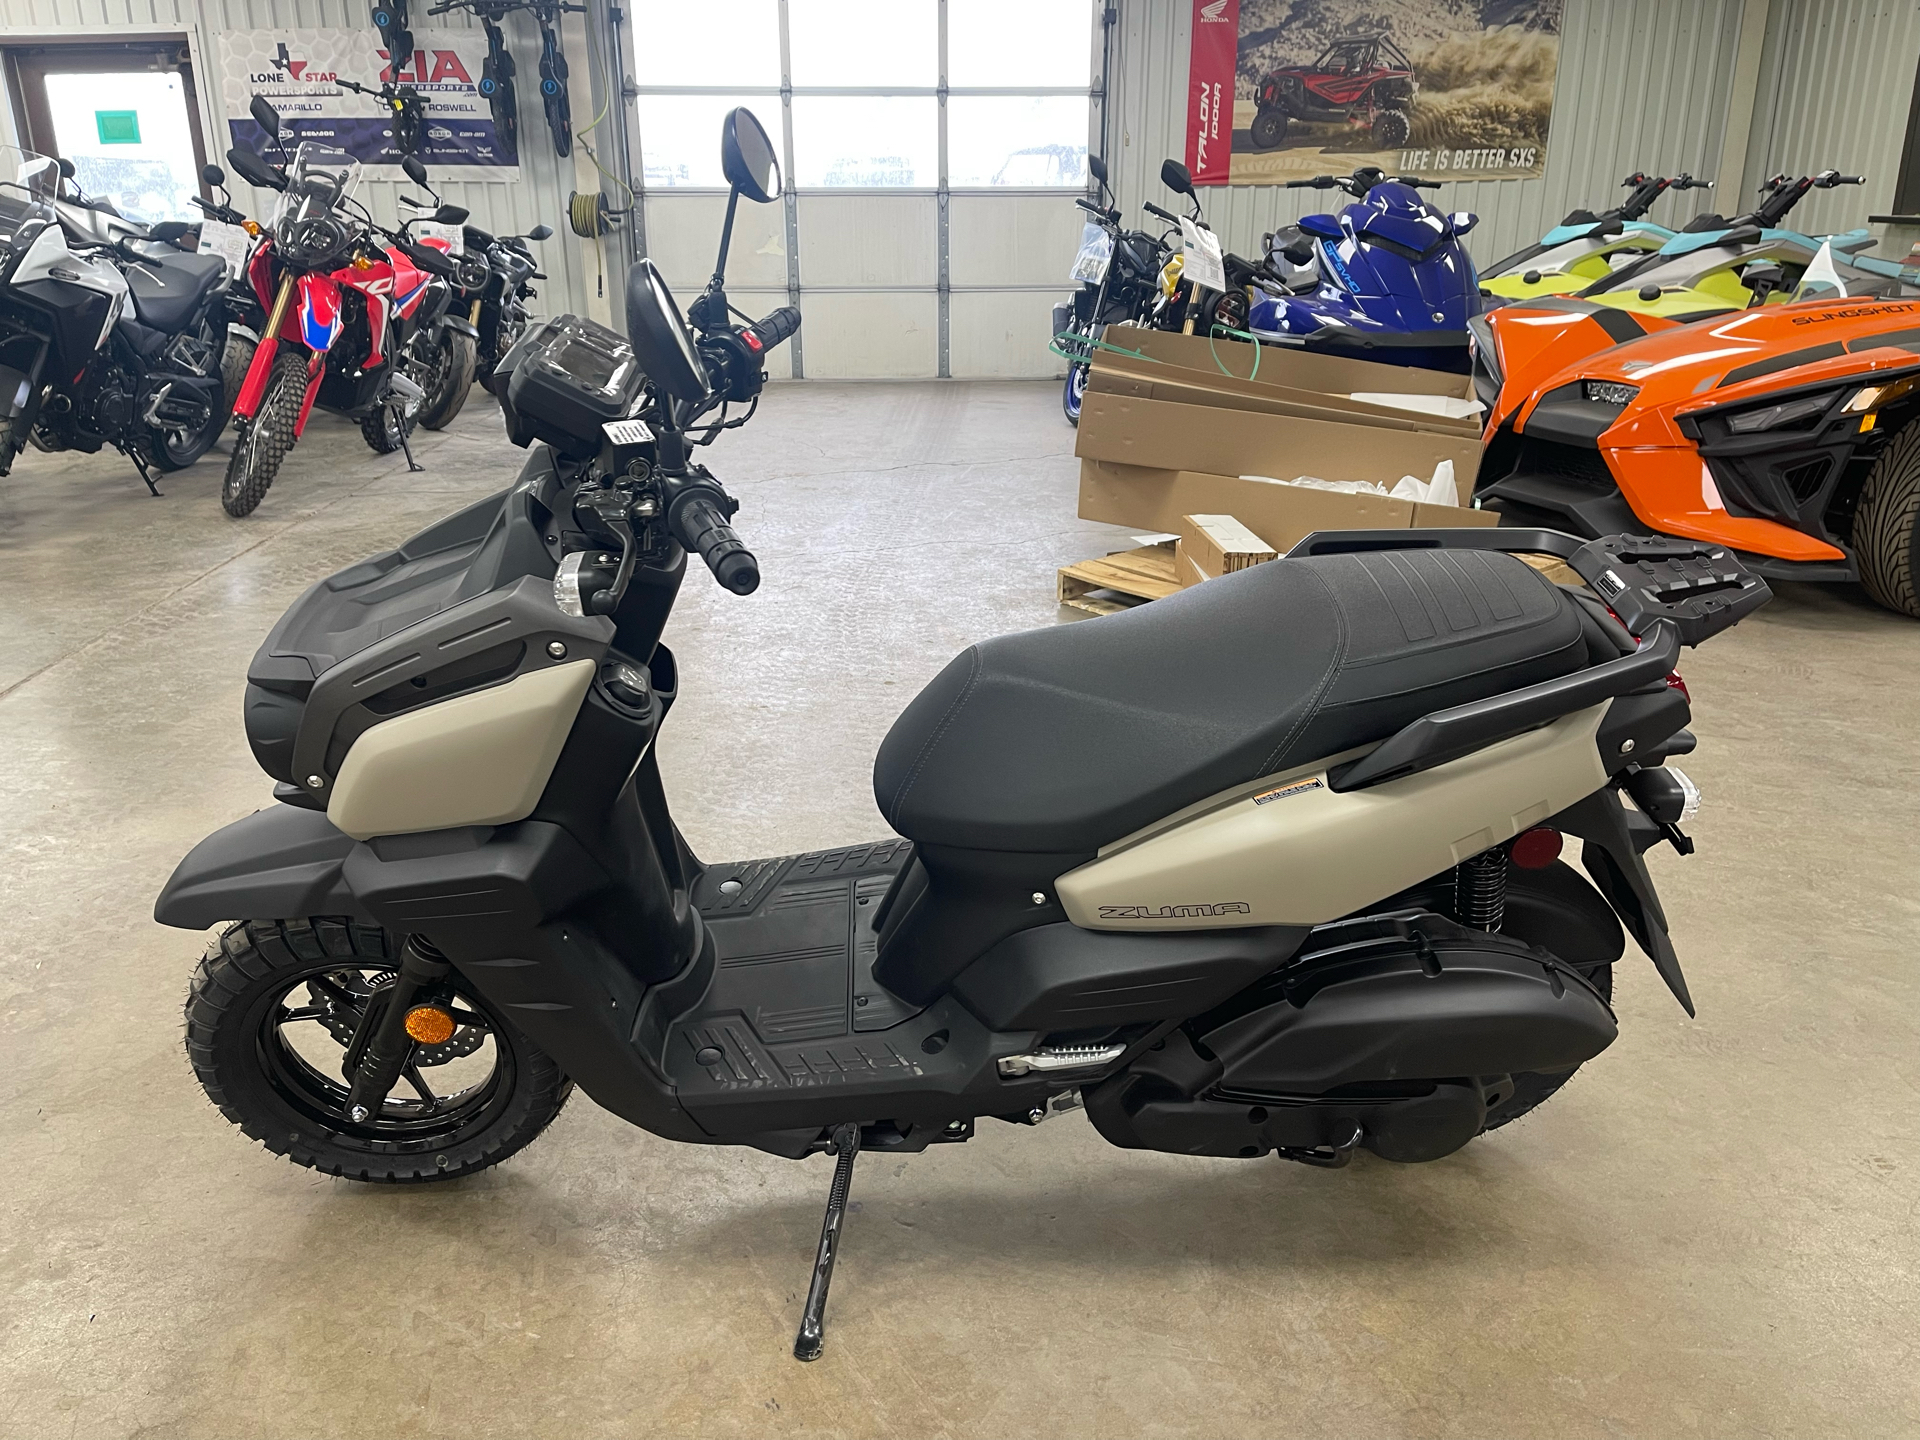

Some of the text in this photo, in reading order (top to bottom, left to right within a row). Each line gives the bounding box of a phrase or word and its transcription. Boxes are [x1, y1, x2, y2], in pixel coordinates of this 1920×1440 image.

[250, 72, 337, 83] LONE STAR
[376, 50, 473, 83] ZIA
[252, 86, 338, 95] POWERSPORTS
[271, 104, 322, 112] AMARILLO
[429, 104, 477, 112] ROSWELL
[1211, 82, 1222, 140] 1000R
[1197, 81, 1210, 174] TALON
[1400, 147, 1536, 171] LIFE IS BETTER SXS
[1323, 240, 1361, 293] GP SVHO
[1791, 304, 1914, 326] SLINGSHOT
[1098, 902, 1250, 918] ZUMA
